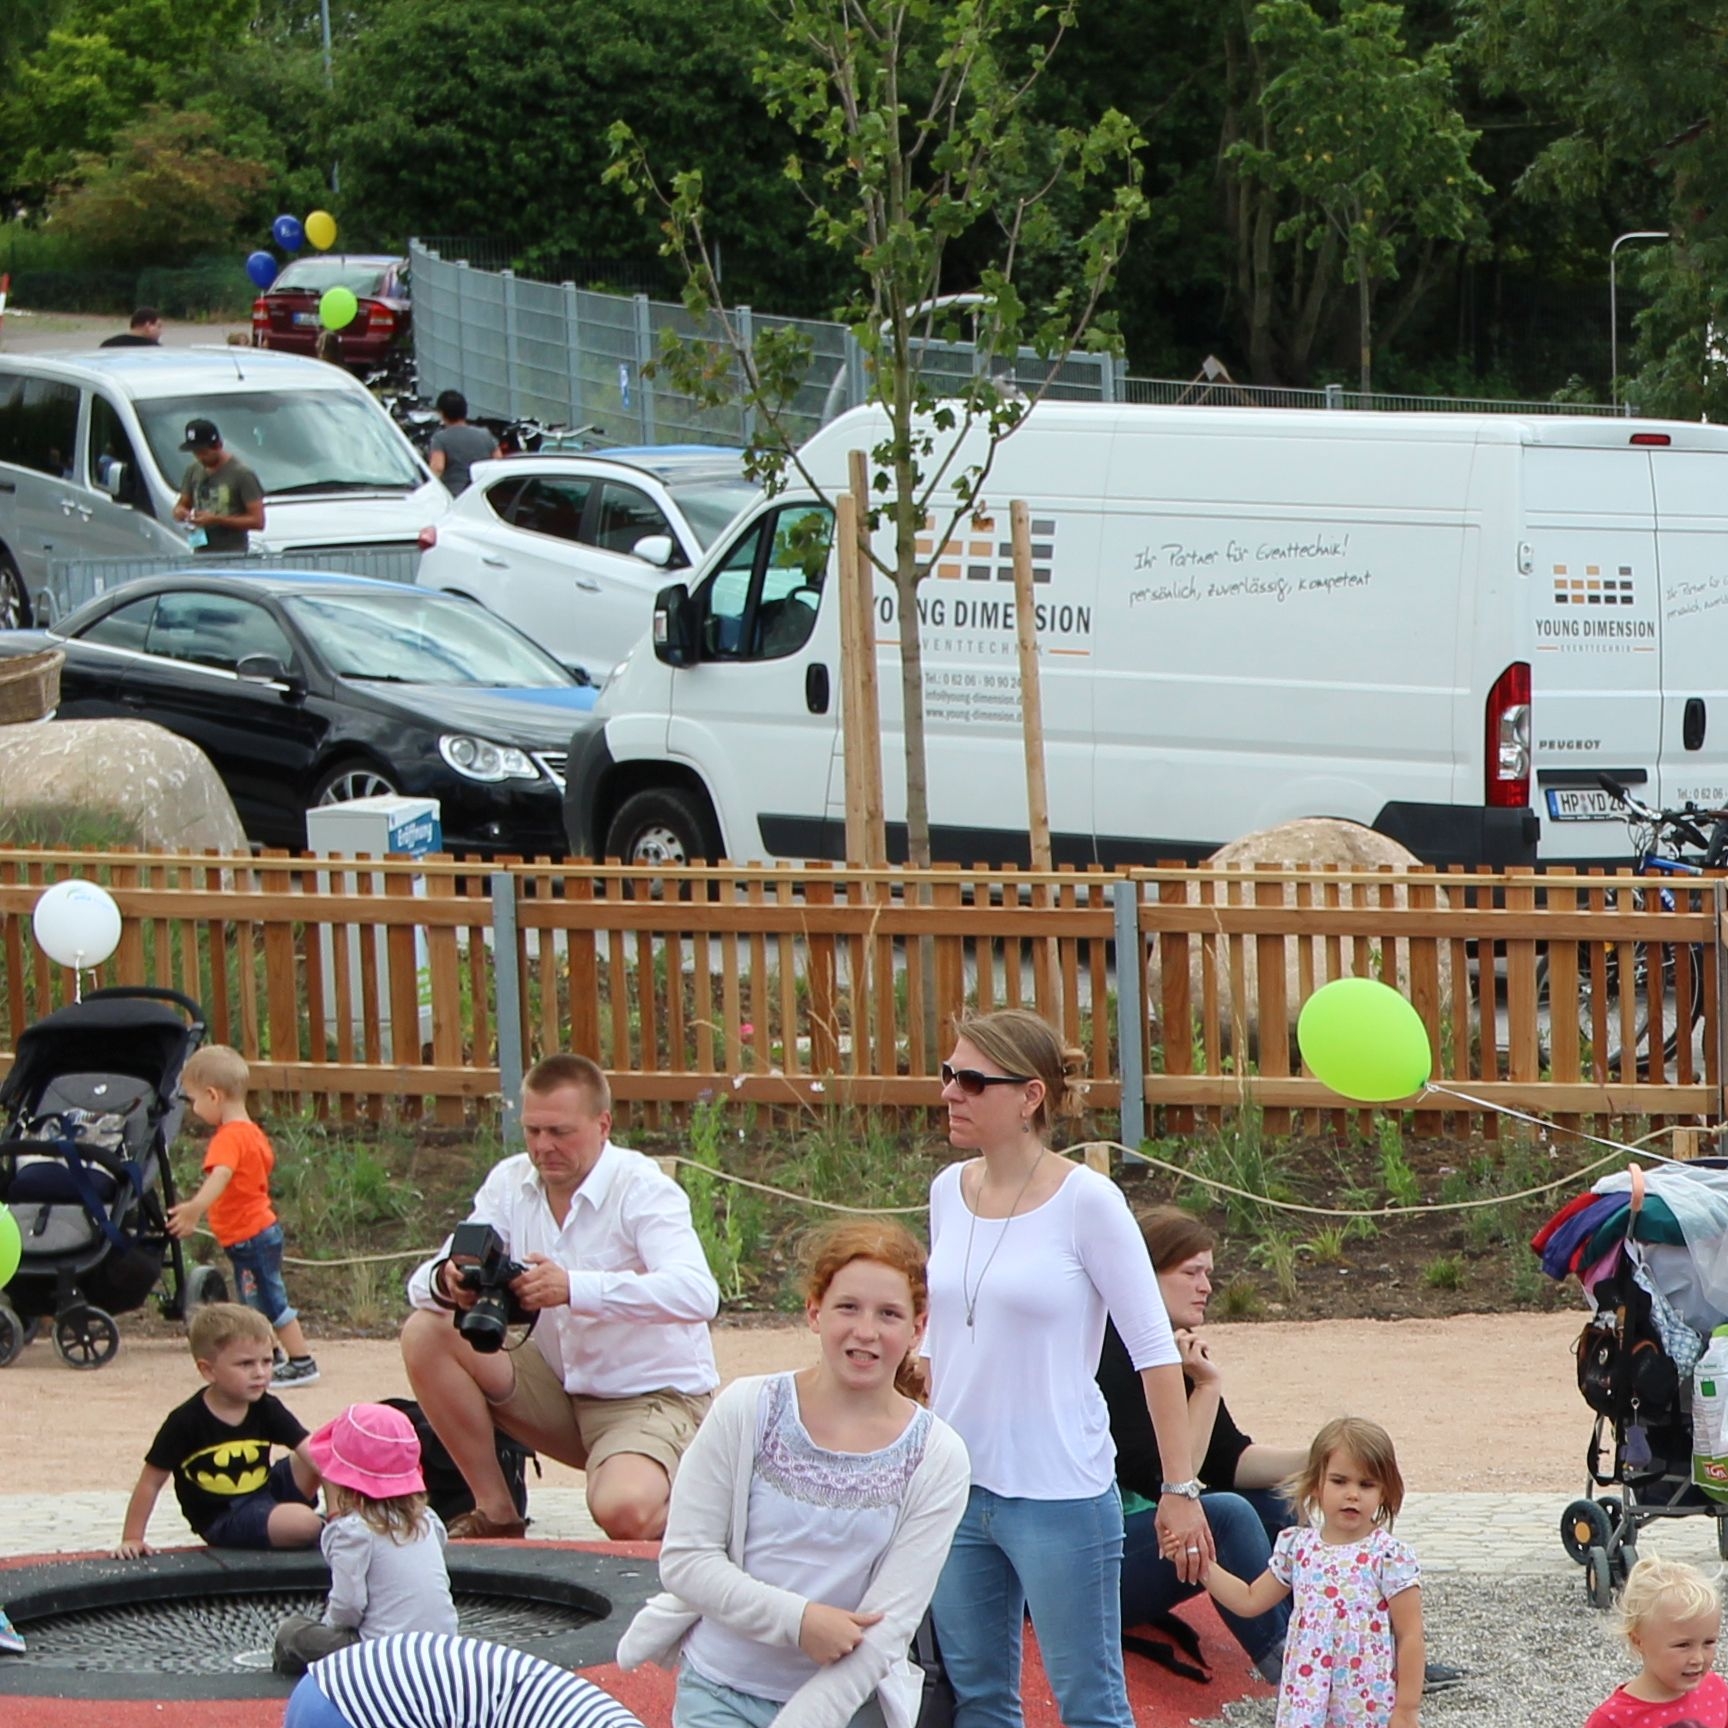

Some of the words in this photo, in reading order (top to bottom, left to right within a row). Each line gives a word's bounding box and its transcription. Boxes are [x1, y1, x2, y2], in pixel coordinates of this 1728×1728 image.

[1134, 547, 1157, 570] Ihr
[1161, 543, 1219, 567] Partner
[1226, 540, 1248, 563] für
[1256, 534, 1349, 561] Eventtechnik!
[1129, 575, 1200, 607] persönlich,
[1208, 576, 1293, 602] zuverlässig,
[954, 601, 1091, 633] DIMESION
[1536, 620, 1579, 637] YOUNG
[1584, 621, 1655, 638] DIMENSION
[1539, 740, 1601, 750] PEUGEOT
[1560, 793, 1579, 812] HP
[1587, 793, 1606, 812] YD
